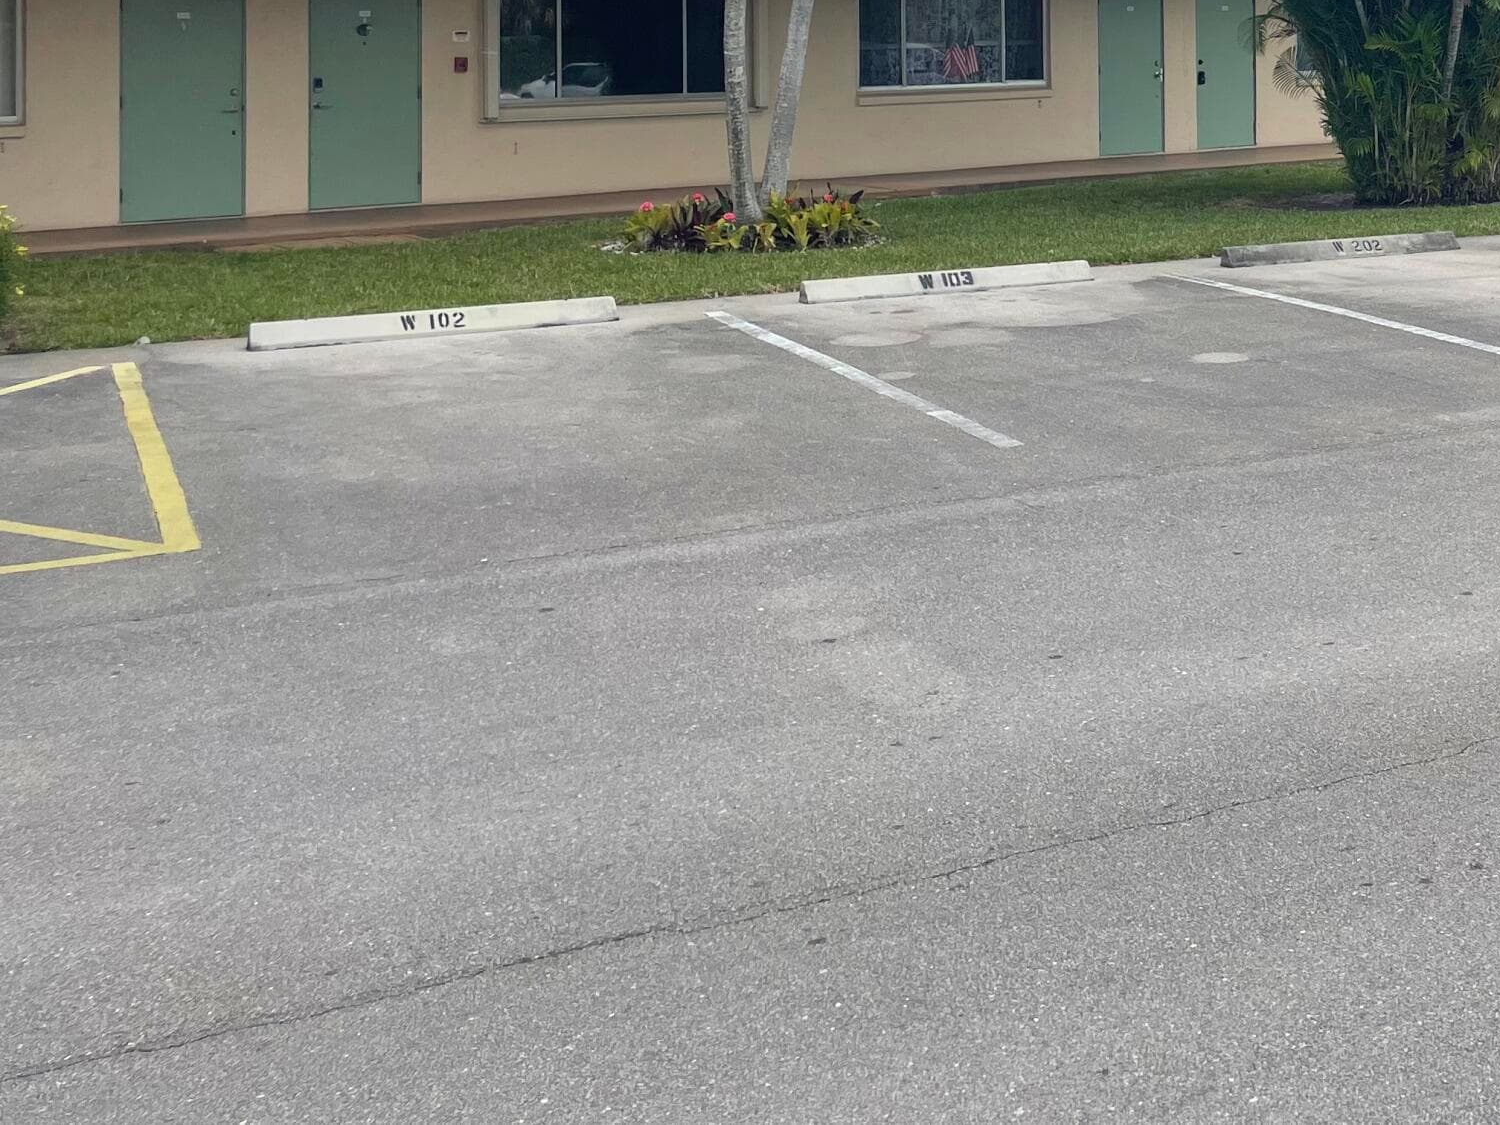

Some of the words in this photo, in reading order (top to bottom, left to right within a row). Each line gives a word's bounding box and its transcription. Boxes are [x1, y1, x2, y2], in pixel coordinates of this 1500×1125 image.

[1351, 239, 1382, 252] 202
[918, 274, 934, 289] W
[941, 271, 974, 287] 103
[400, 315, 416, 331] W
[429, 312, 466, 330] 102
